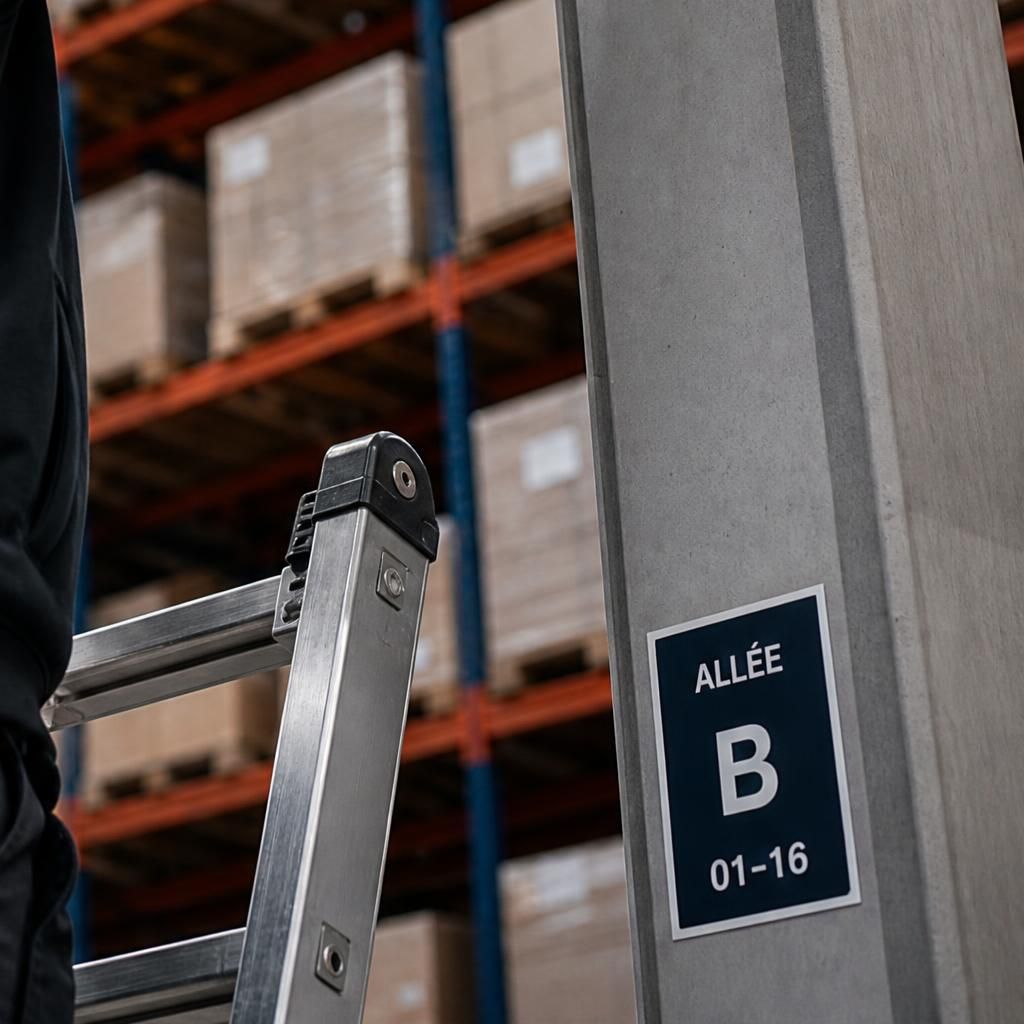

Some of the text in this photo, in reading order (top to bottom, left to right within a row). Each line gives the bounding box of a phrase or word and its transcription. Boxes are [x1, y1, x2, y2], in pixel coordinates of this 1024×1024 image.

[695, 641, 784, 694] ALLÉE
[715, 723, 779, 817] B
[710, 841, 809, 892] 01-16
